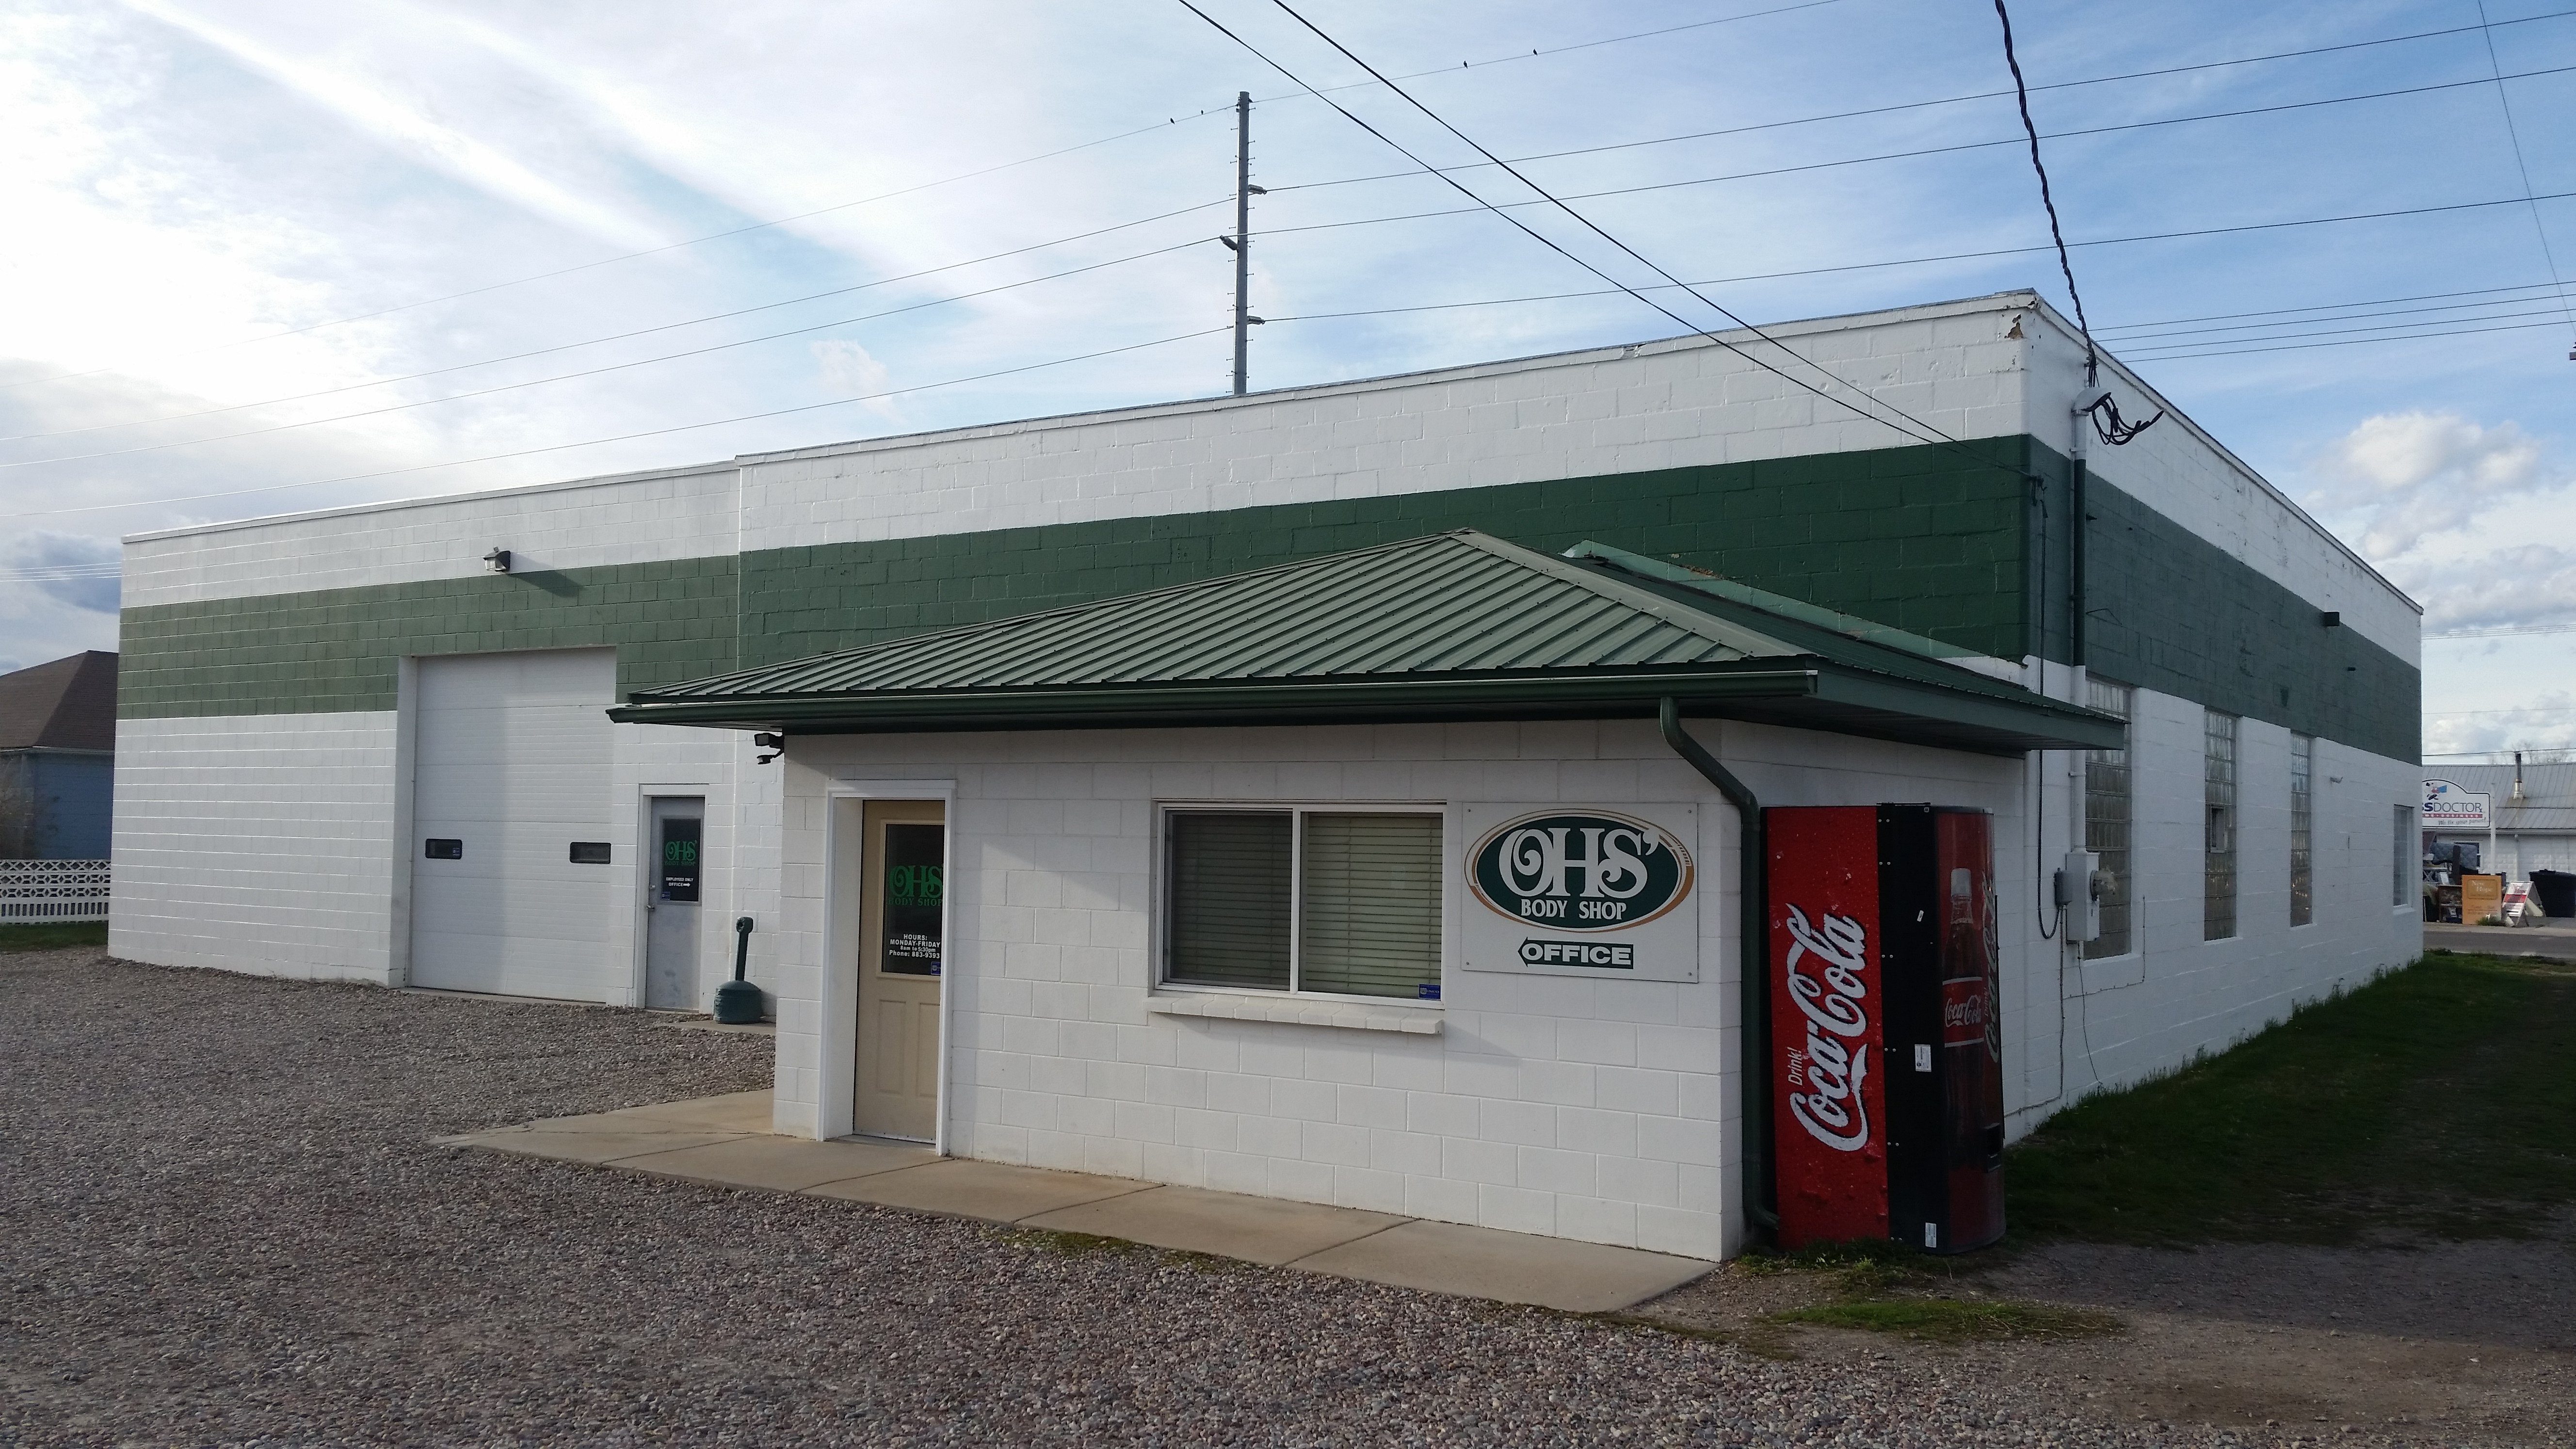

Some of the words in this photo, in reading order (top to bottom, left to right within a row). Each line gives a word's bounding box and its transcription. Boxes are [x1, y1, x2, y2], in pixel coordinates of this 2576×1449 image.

[888, 897, 914, 905] BODY
[1520, 899, 1567, 918] BODY
[1578, 900, 1626, 920] SHOP
[1521, 943, 1632, 965] OFFICE
[1786, 903, 1868, 1152] Coca-Cola
[1787, 1047, 1803, 1086] Drink!
